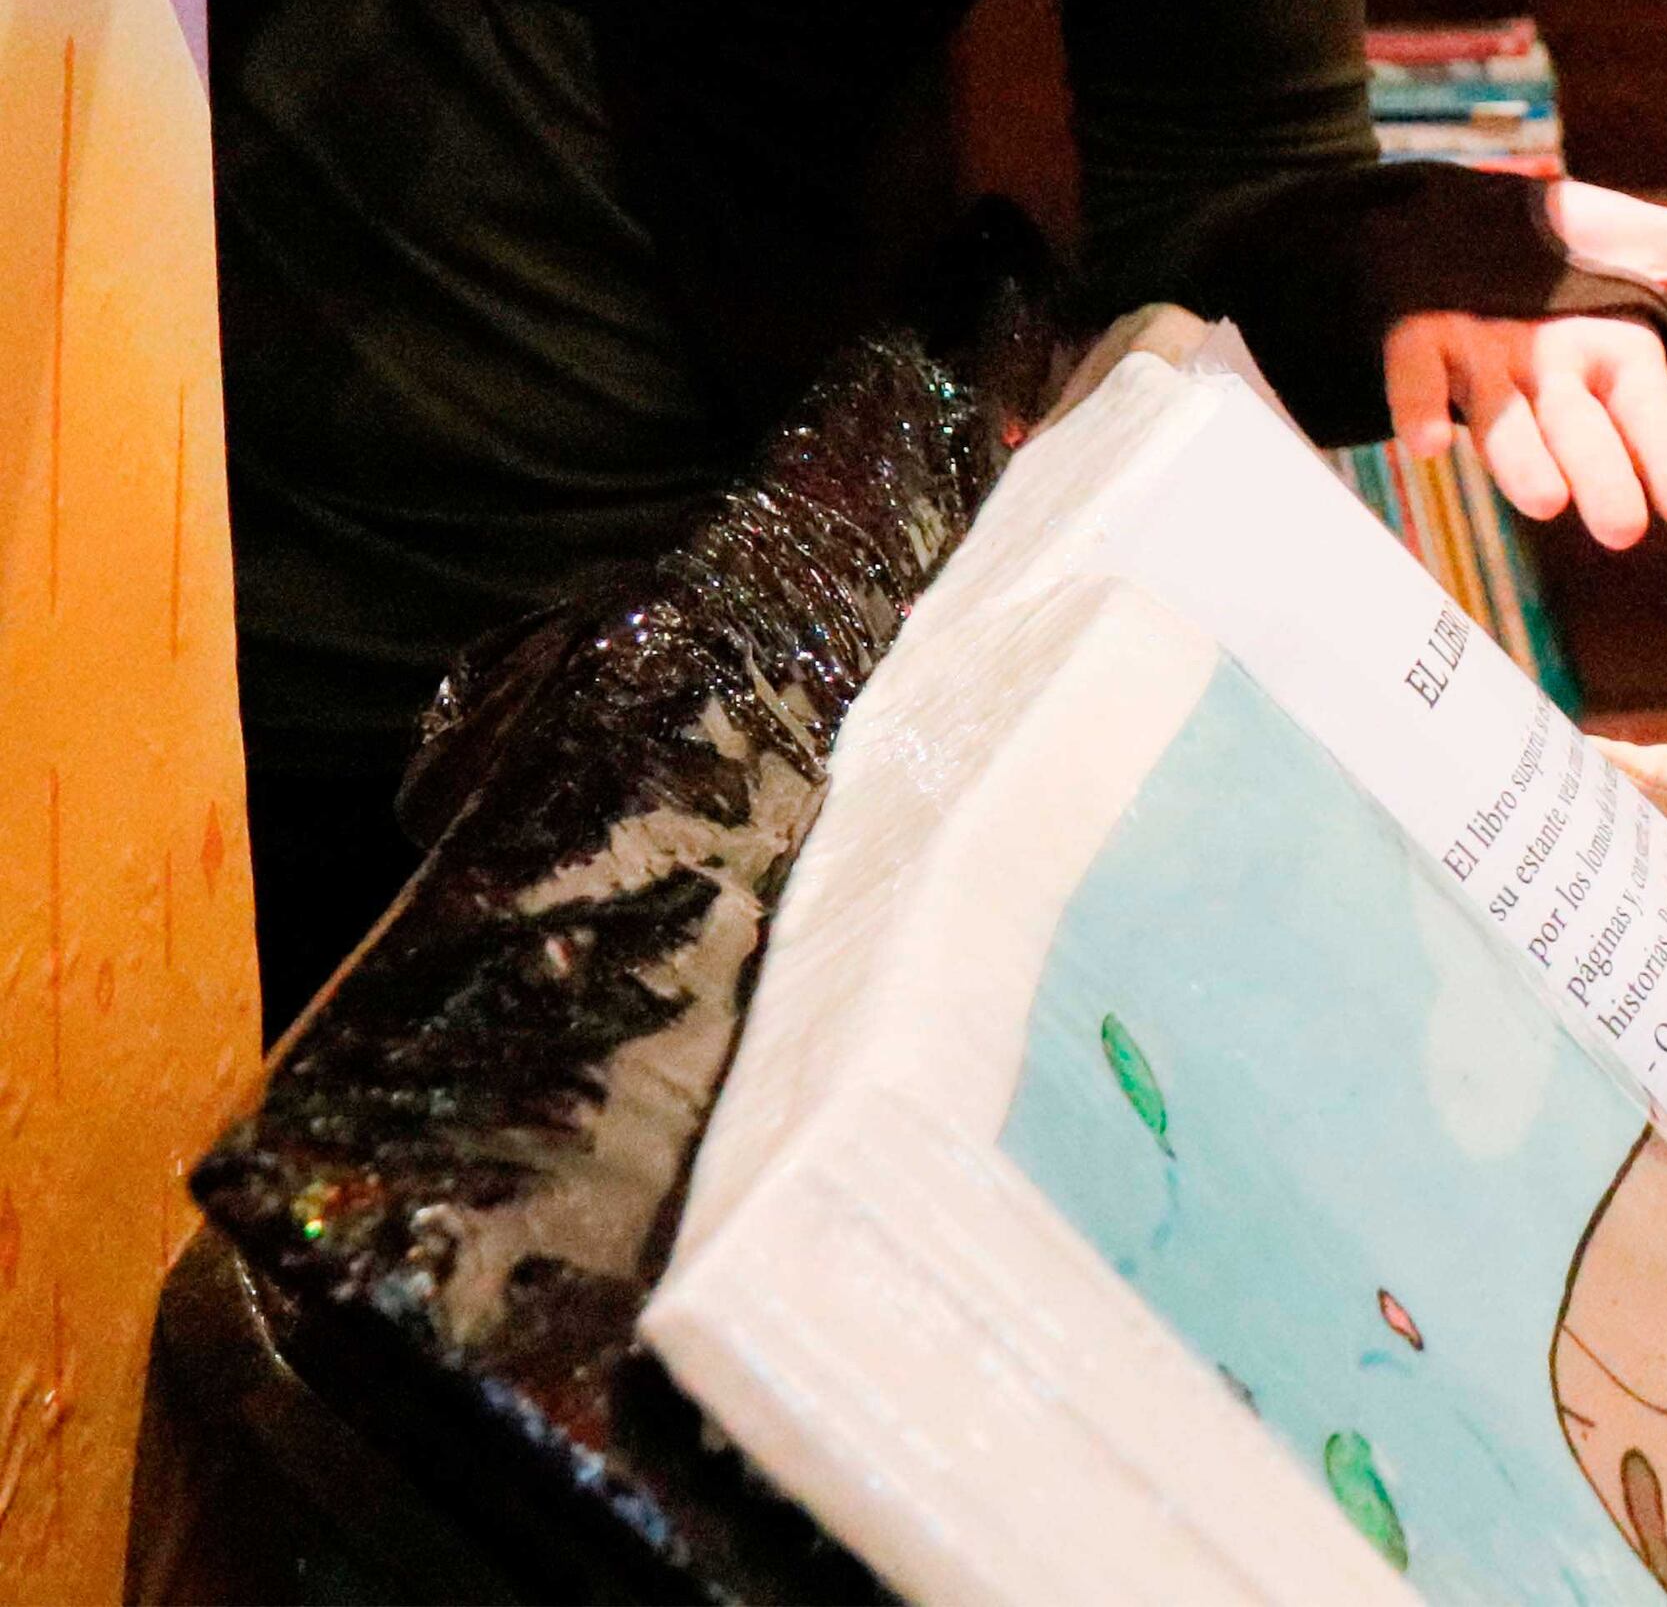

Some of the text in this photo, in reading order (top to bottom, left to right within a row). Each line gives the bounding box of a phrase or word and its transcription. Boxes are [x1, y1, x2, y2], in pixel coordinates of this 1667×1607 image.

[1403, 658, 1449, 709] EL
[1441, 839, 1479, 882] El
[1465, 789, 1517, 849] libro
[1488, 885, 1519, 922] su
[1515, 807, 1570, 885] estante,
[1527, 906, 1566, 968] por
[1554, 870, 1591, 911] los
[1574, 818, 1613, 875] lomos
[1565, 905, 1631, 1009] páginas
[1621, 892, 1643, 916] y,
